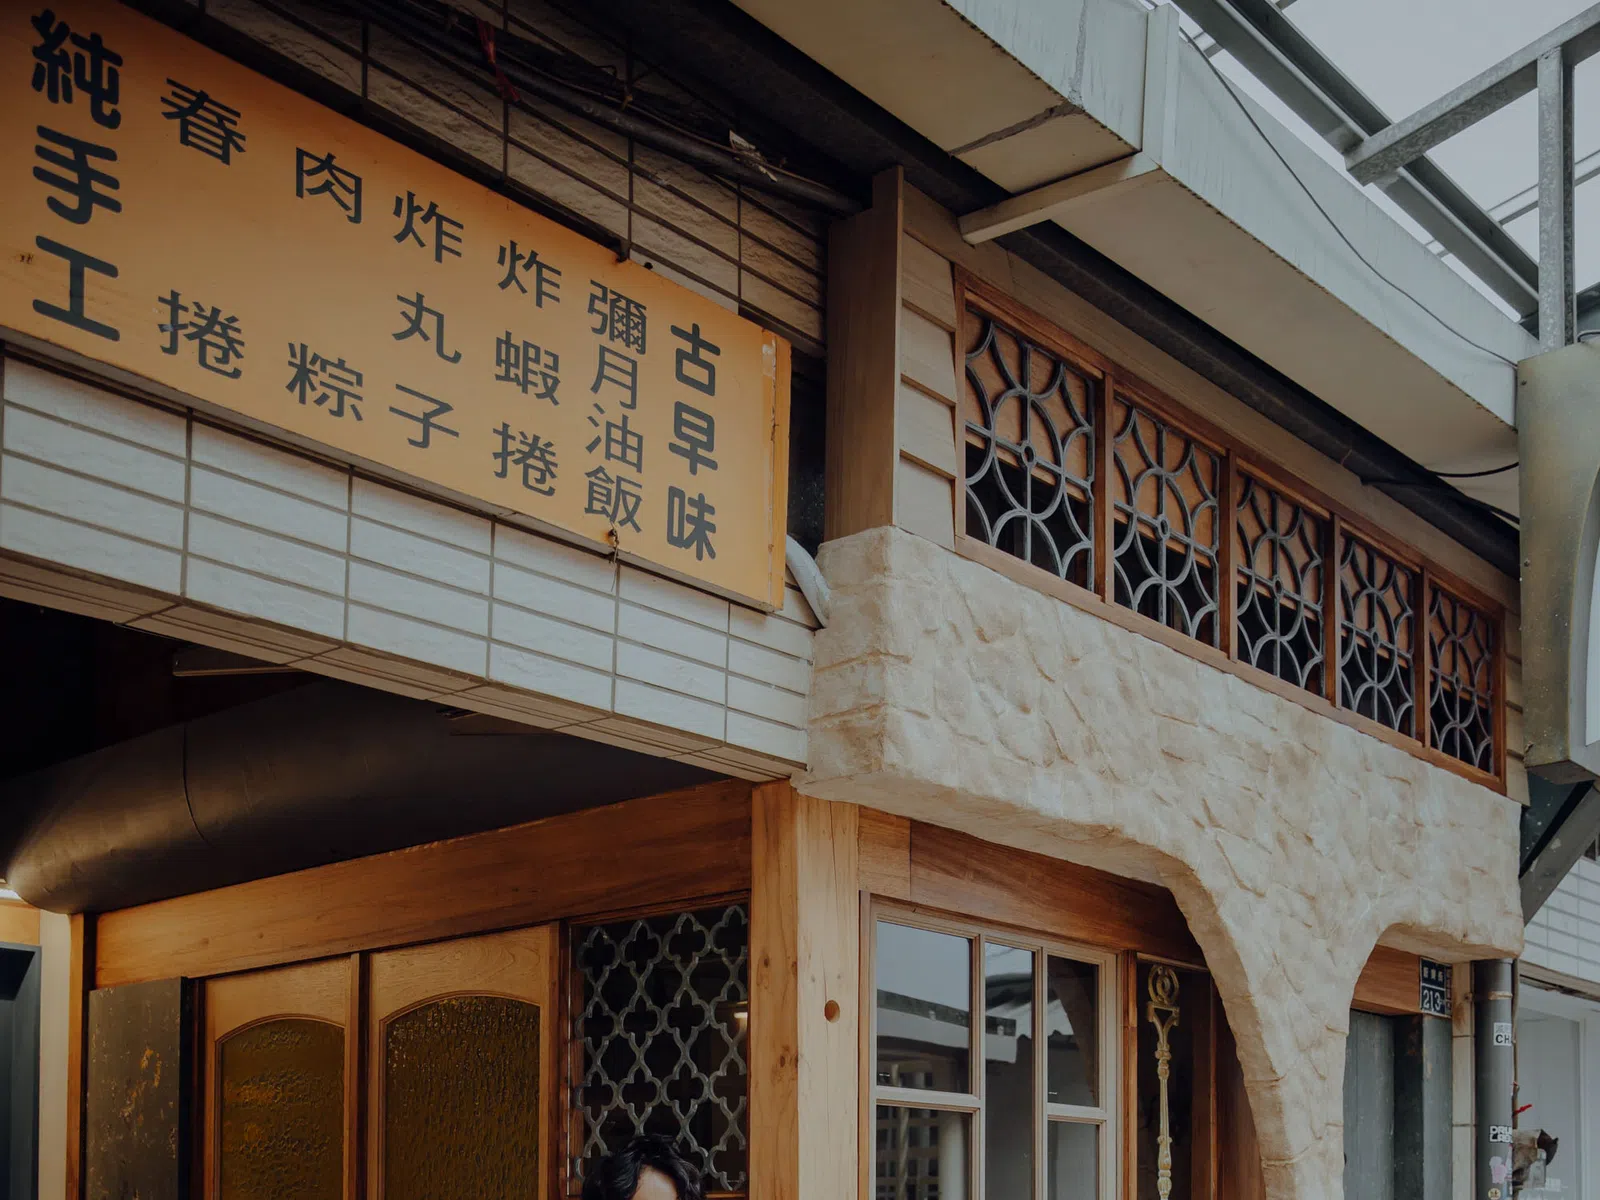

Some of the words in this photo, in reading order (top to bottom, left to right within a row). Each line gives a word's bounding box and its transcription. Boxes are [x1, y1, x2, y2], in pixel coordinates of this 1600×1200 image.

[30, 9, 123, 342] 純手工
[158, 78, 246, 379] 春捲
[286, 148, 363, 421] 肉粽
[389, 191, 463, 448] 炸丸子
[492, 241, 561, 496] 炸蝦捲
[585, 280, 646, 532] 彌月油飯
[667, 324, 720, 561] 古早味
[1423, 989, 1442, 1012] 213
